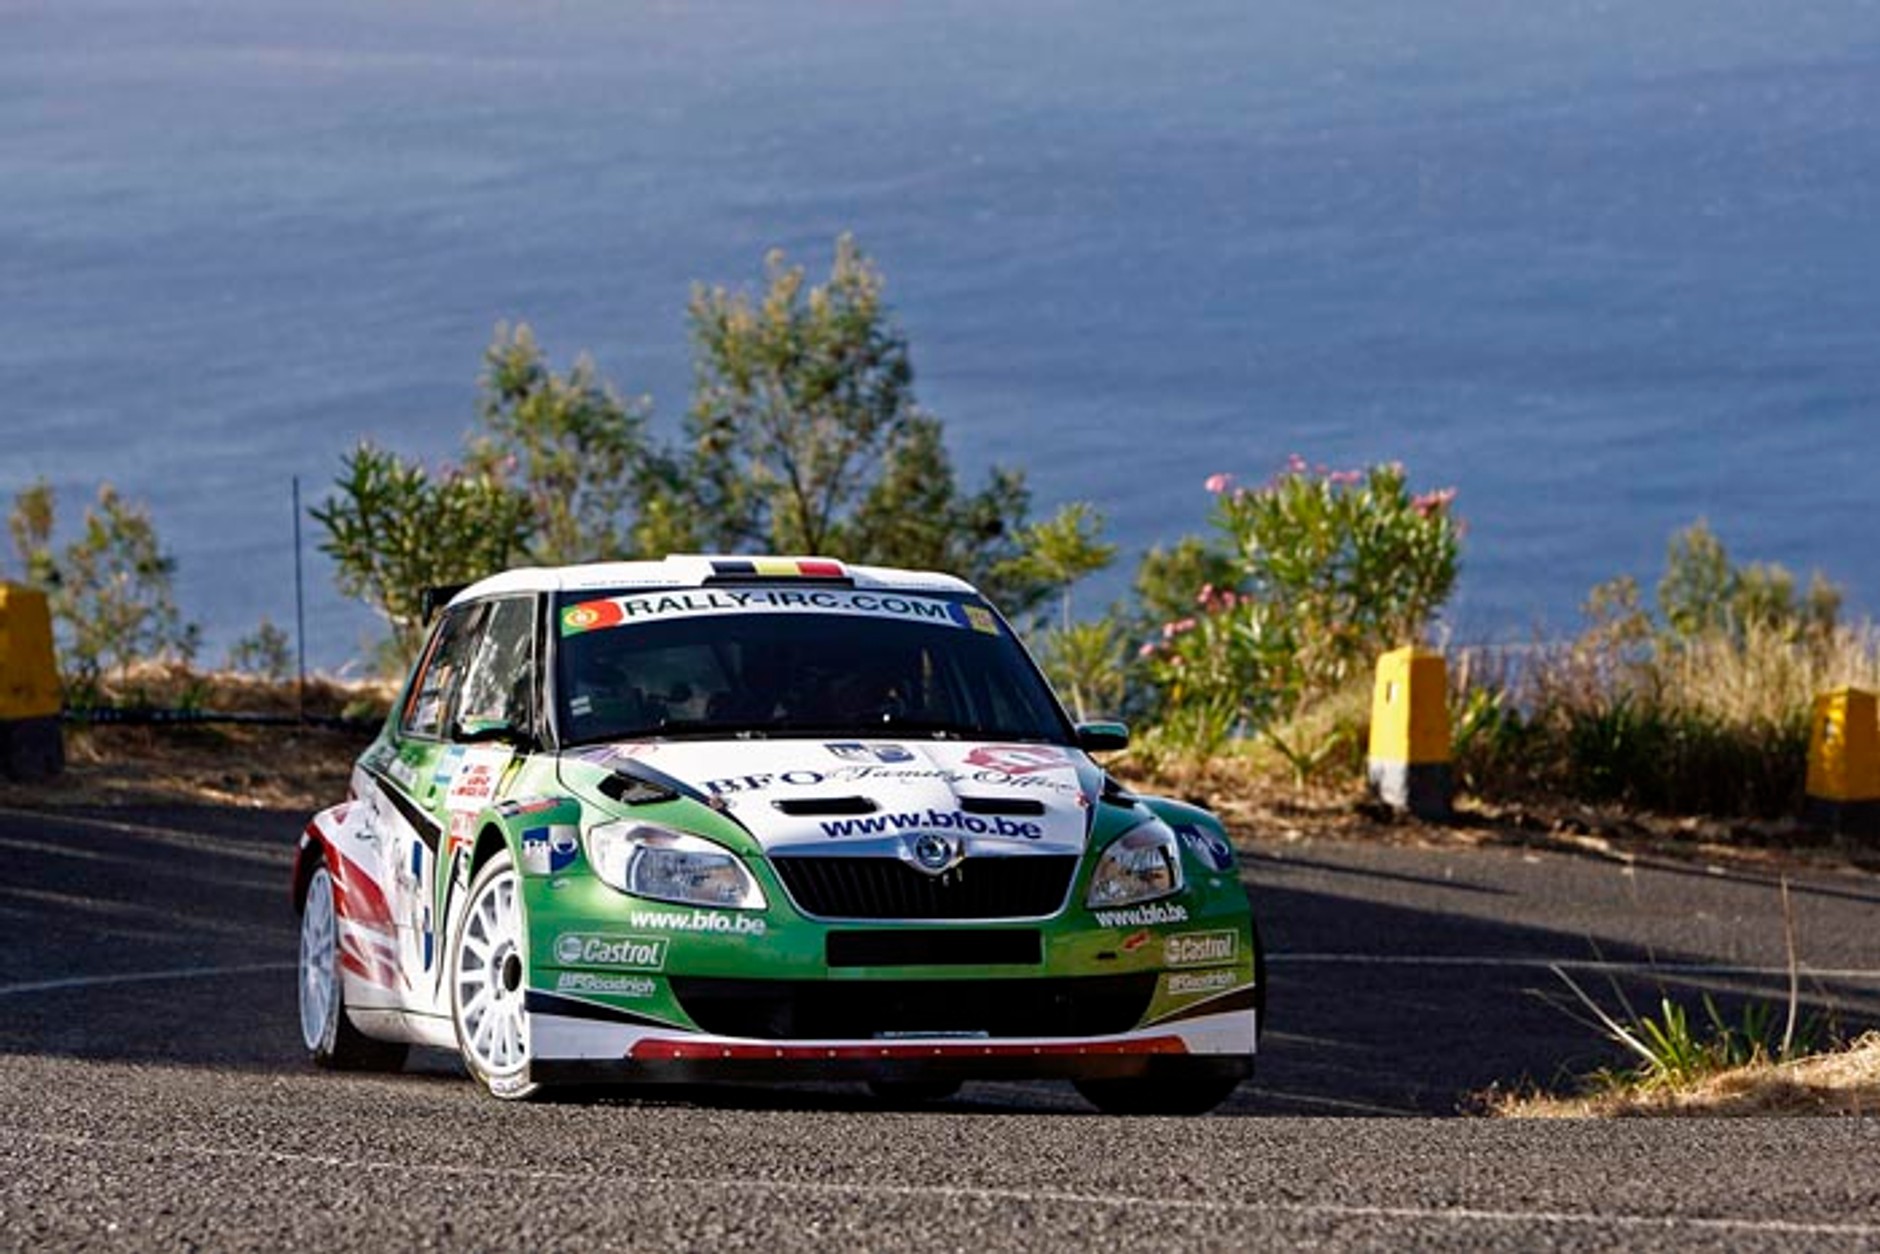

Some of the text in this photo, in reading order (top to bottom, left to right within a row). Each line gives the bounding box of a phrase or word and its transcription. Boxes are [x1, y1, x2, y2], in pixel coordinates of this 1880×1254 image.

[624, 590, 946, 619] RALLY-IRC.COM
[700, 772, 824, 795] BFO
[820, 809, 1042, 840] www.bfo.be
[630, 910, 767, 935] www.bfo.be
[1095, 902, 1189, 927] www.bfo.be
[583, 937, 660, 965] Castrol
[1181, 934, 1232, 962] Castrol
